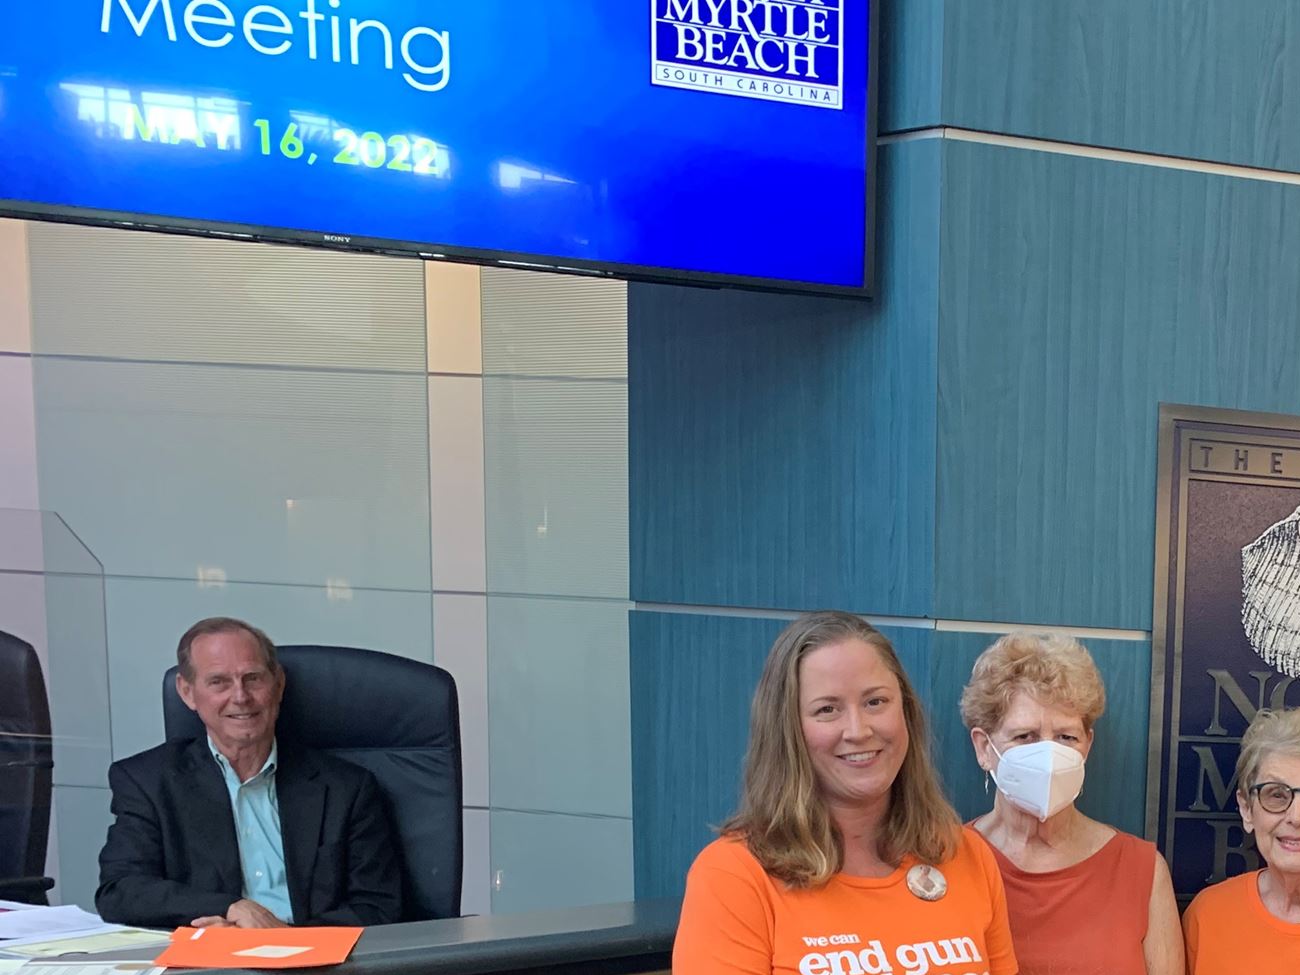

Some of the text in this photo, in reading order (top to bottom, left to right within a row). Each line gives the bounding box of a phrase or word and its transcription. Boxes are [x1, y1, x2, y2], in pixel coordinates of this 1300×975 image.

[663, 0, 831, 43] MYRTLE
[101, 0, 451, 92] Meeting
[673, 23, 820, 79] BEACH
[663, 68, 831, 101] SOUTH CAROLINA
[122, 102, 440, 175] MAY 16, 2022
[1200, 449, 1284, 474] THE
[802, 934, 861, 947] we can
